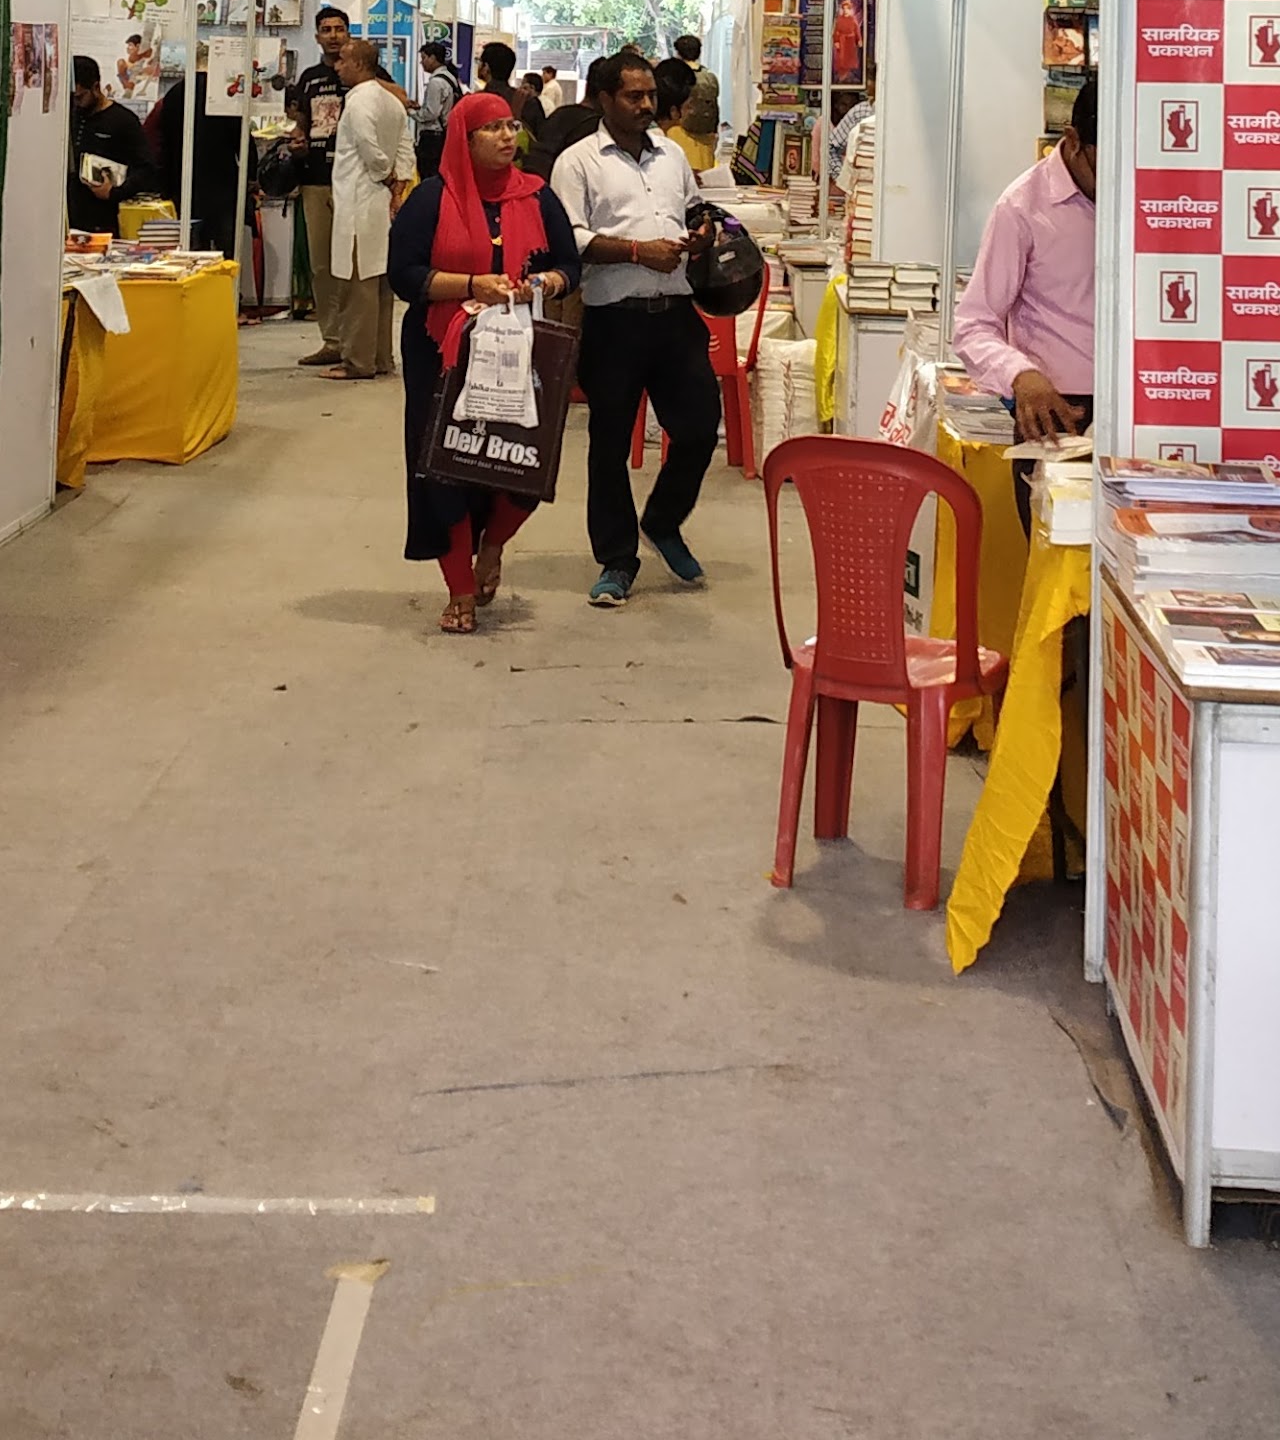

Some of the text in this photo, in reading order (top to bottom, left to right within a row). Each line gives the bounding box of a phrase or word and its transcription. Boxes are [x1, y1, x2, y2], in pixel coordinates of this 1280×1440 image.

[1141, 23, 1221, 42] सामयिक
[1147, 44, 1214, 57] प्रकाशन
[1139, 195, 1219, 214] सामयिक
[1145, 216, 1213, 229] प्रकाशन
[1138, 366, 1218, 385] सामयिक
[1144, 387, 1212, 401] प्रकाशन
[443, 425, 485, 455] Dev
[486, 434, 540, 469] Bros.
